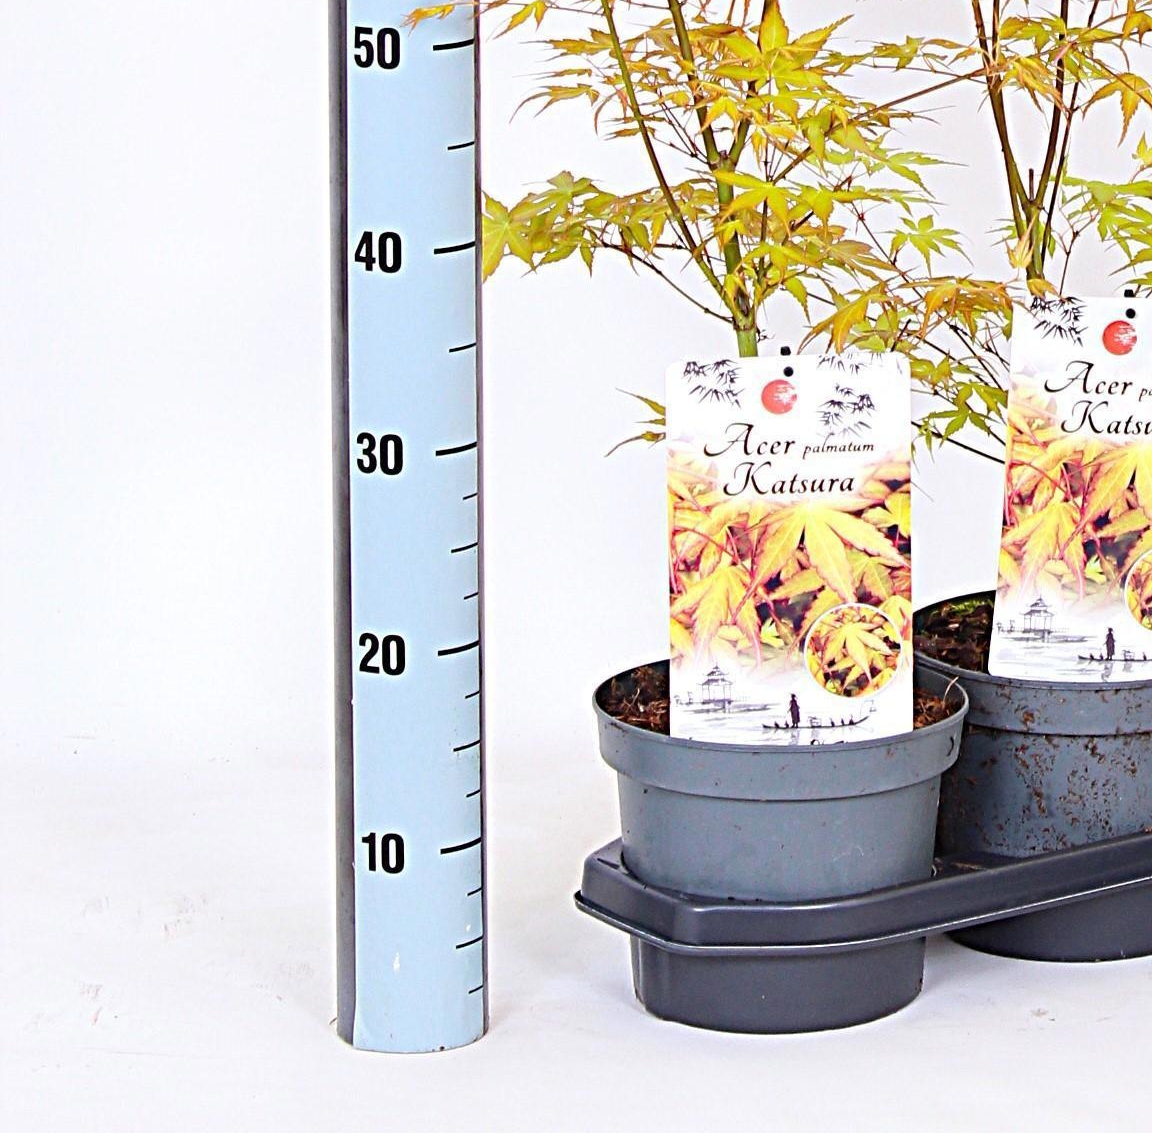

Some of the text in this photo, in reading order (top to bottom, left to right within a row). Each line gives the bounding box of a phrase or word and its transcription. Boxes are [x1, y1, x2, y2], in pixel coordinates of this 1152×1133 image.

[354, 26, 401, 70] 50
[354, 231, 402, 273] 40
[1044, 360, 1133, 396] Acer
[355, 433, 403, 475] 30
[703, 423, 875, 461] Acer palmatum
[723, 461, 855, 496] Katsura
[358, 633, 405, 675] 20
[361, 833, 405, 874] 10
